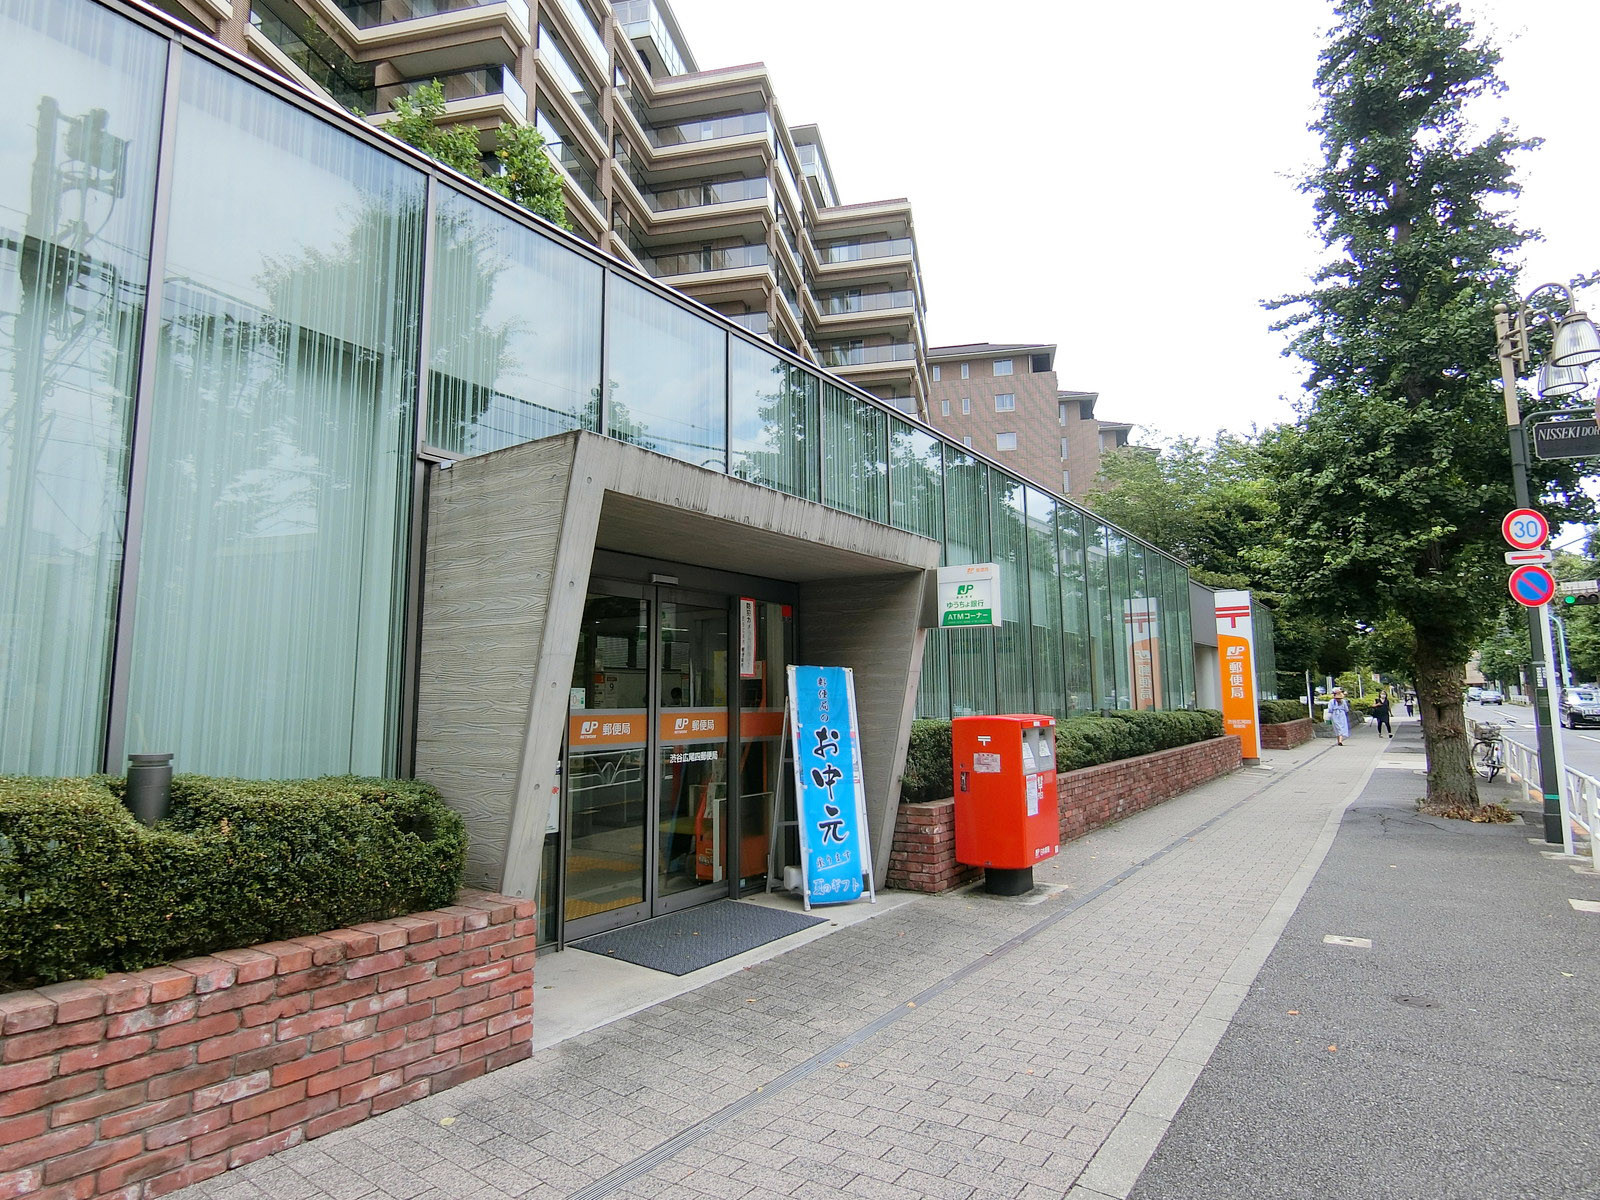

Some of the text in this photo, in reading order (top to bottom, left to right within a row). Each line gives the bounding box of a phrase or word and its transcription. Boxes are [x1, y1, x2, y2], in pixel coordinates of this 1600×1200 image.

[1538, 426, 1580, 440] NISSEKI
[1514, 520, 1538, 538] 30
[957, 584, 974, 595] JP
[946, 600, 984, 609] ゆうちょ銀行
[947, 612, 988, 620] ATMコーナー
[1226, 646, 1245, 656] JP
[1229, 661, 1244, 699] 郵便局
[817, 677, 829, 722] 郵便局の
[581, 721, 631, 736] JP 郵便局
[674, 718, 715, 732] JP 郵便局
[811, 726, 850, 844] お中元
[813, 878, 860, 896] 夏のギフト
